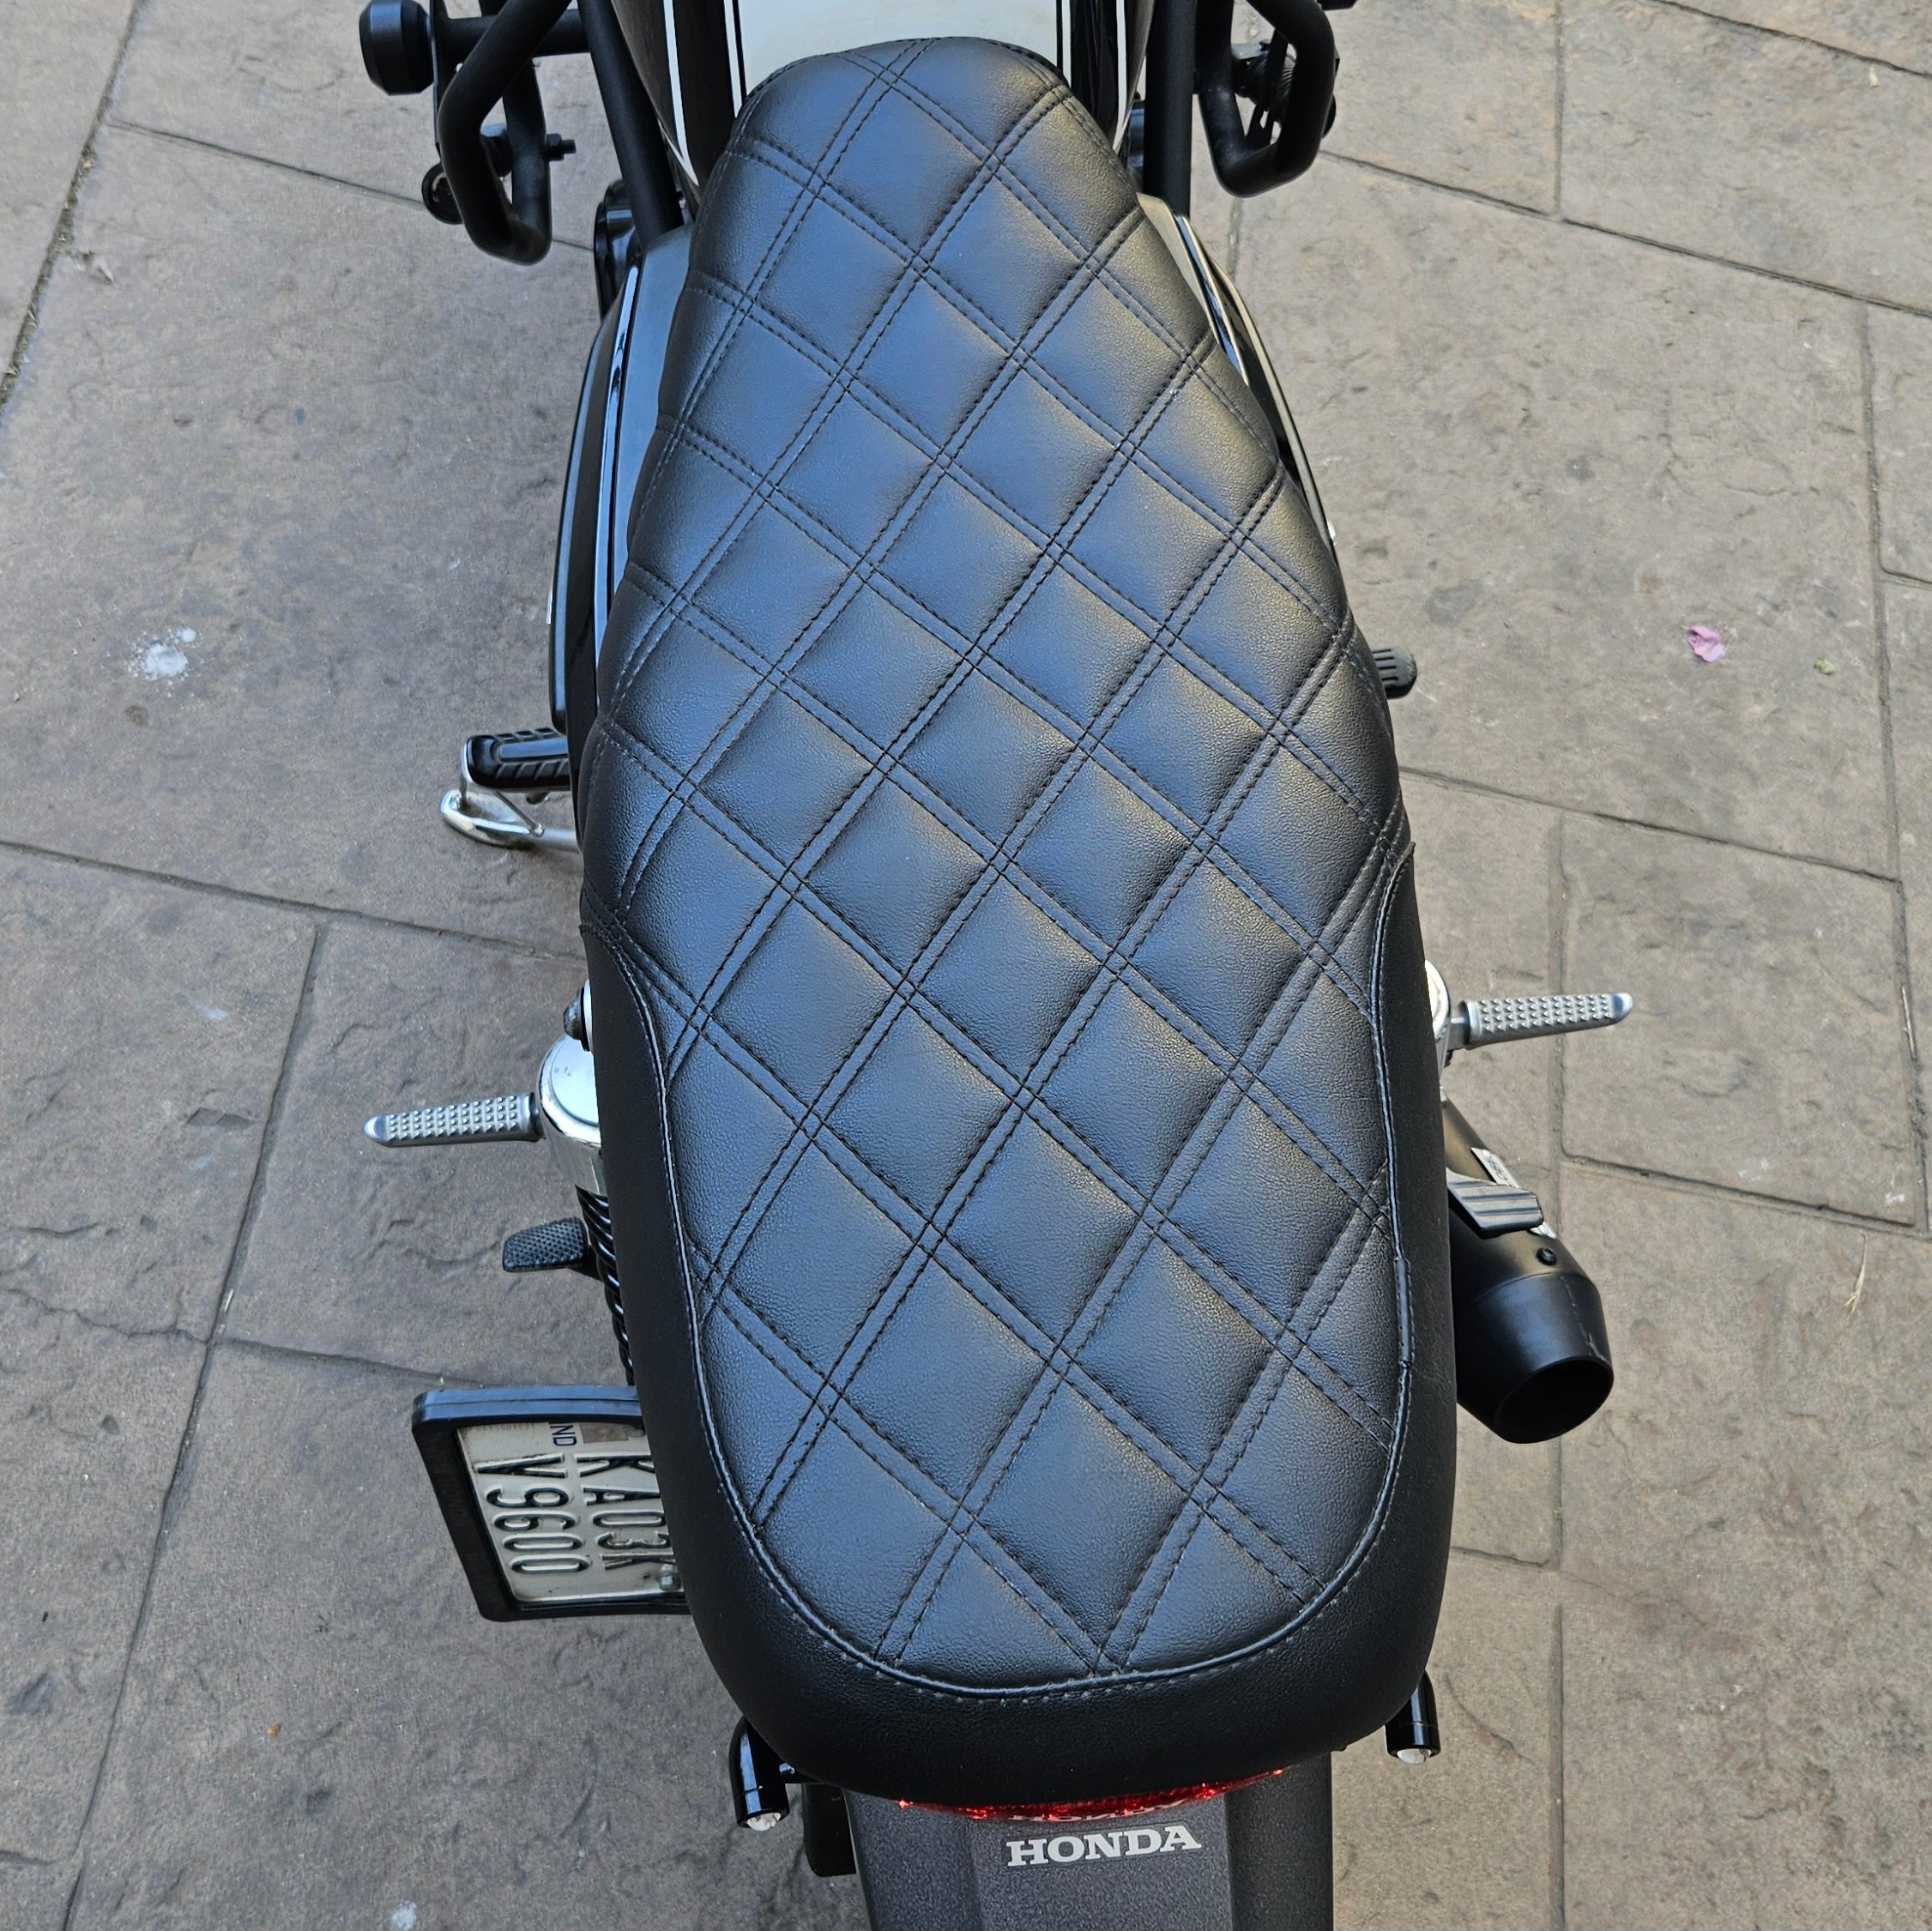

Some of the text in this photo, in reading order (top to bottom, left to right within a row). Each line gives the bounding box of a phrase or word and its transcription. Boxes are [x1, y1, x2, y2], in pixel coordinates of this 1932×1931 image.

[548, 1421, 577, 1447] ND
[474, 1452, 591, 1573] V9600
[1005, 1825, 1202, 1867] HONDA
